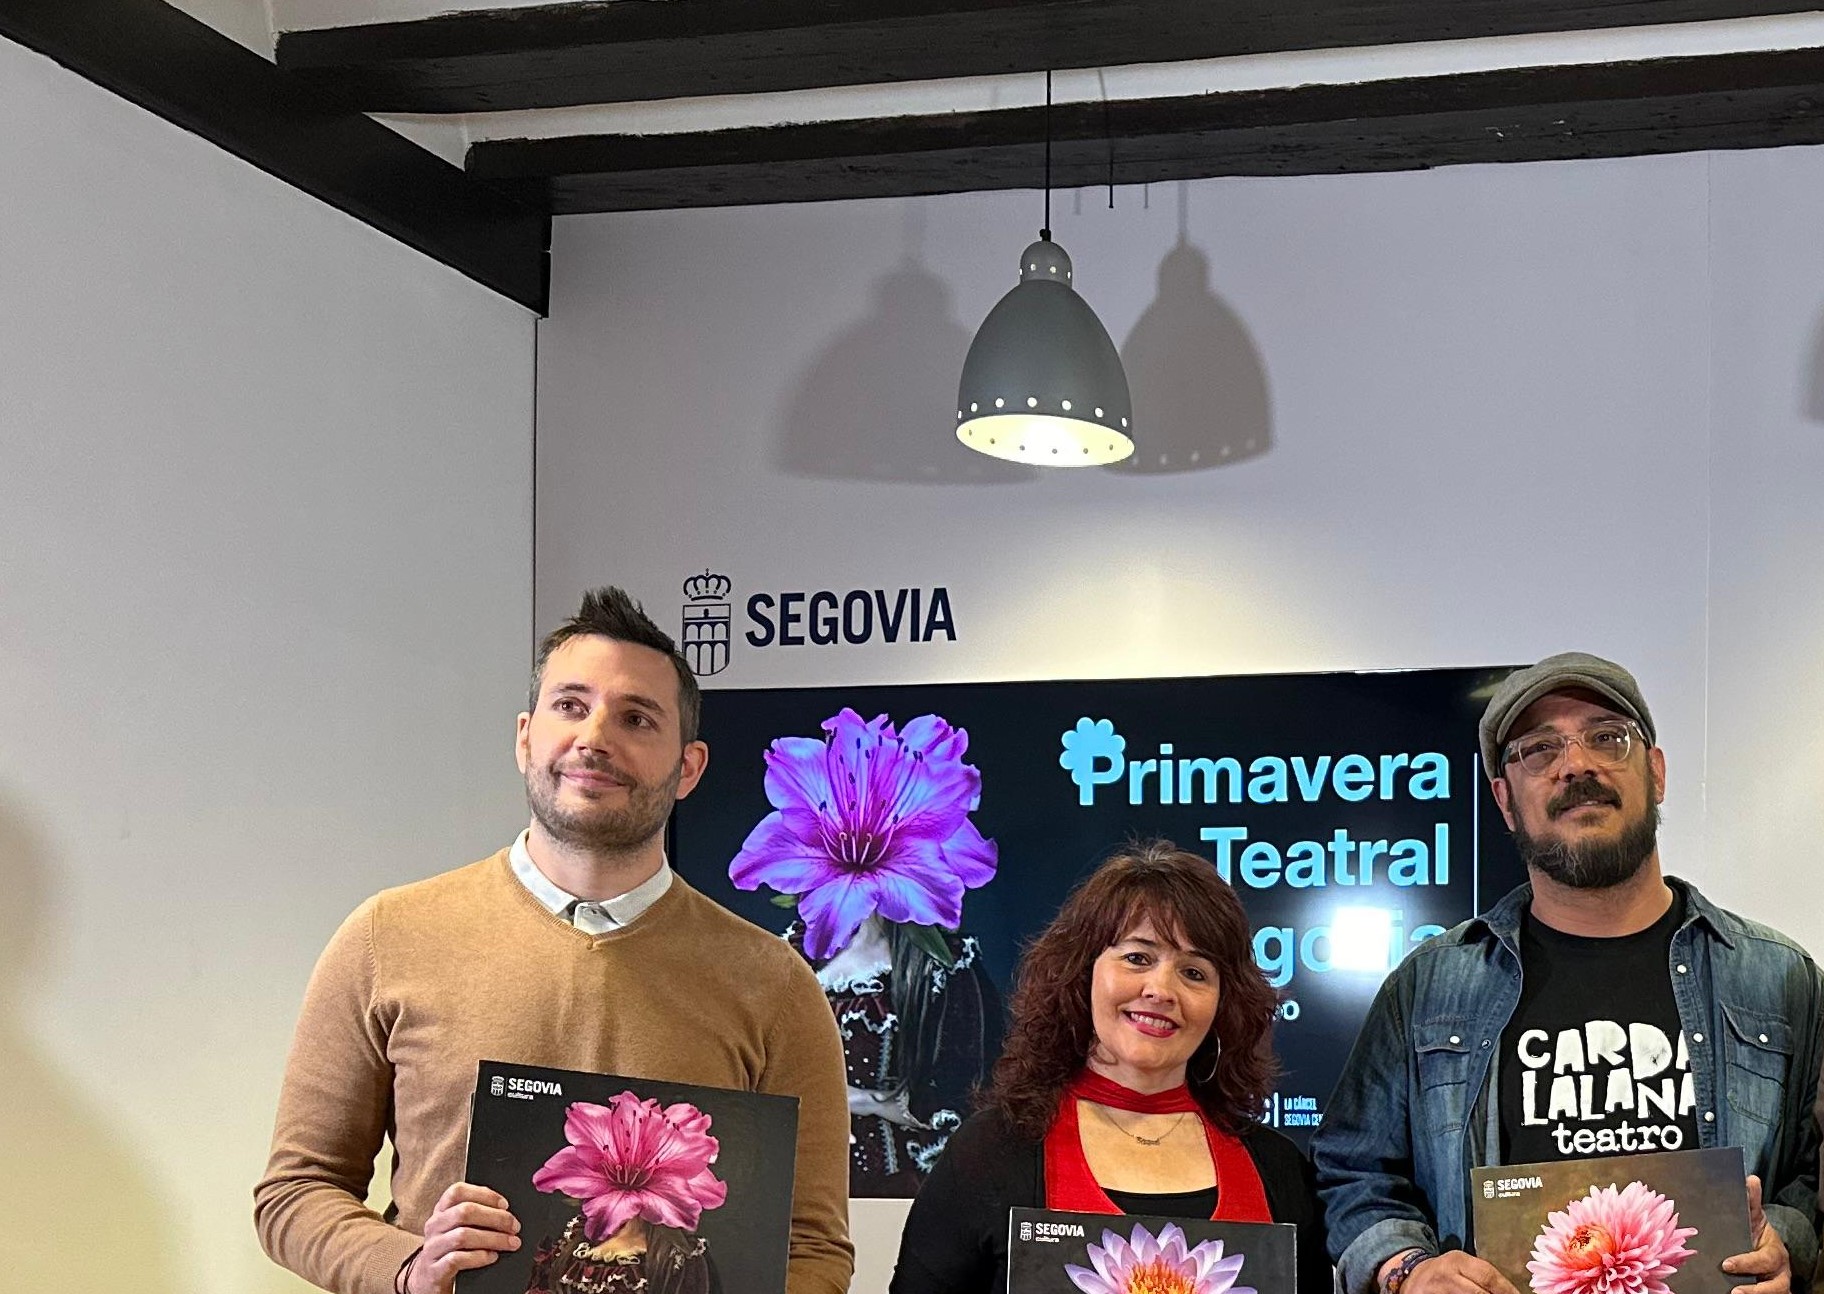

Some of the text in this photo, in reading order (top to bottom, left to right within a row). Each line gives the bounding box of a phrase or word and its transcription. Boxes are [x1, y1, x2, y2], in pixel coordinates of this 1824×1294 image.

[745, 588, 957, 647] SEGOVIA
[1059, 716, 1451, 806] Primavera
[1200, 823, 1449, 888] Teatral
[1517, 1020, 1691, 1080] CARDA
[508, 1077, 562, 1096] SEGOVIA
[1521, 1068, 1696, 1126] LALANA
[1551, 1120, 1683, 1154] teatro
[1497, 1176, 1543, 1190] SEGOVIA
[1035, 1222, 1085, 1237] SEGOVIA
